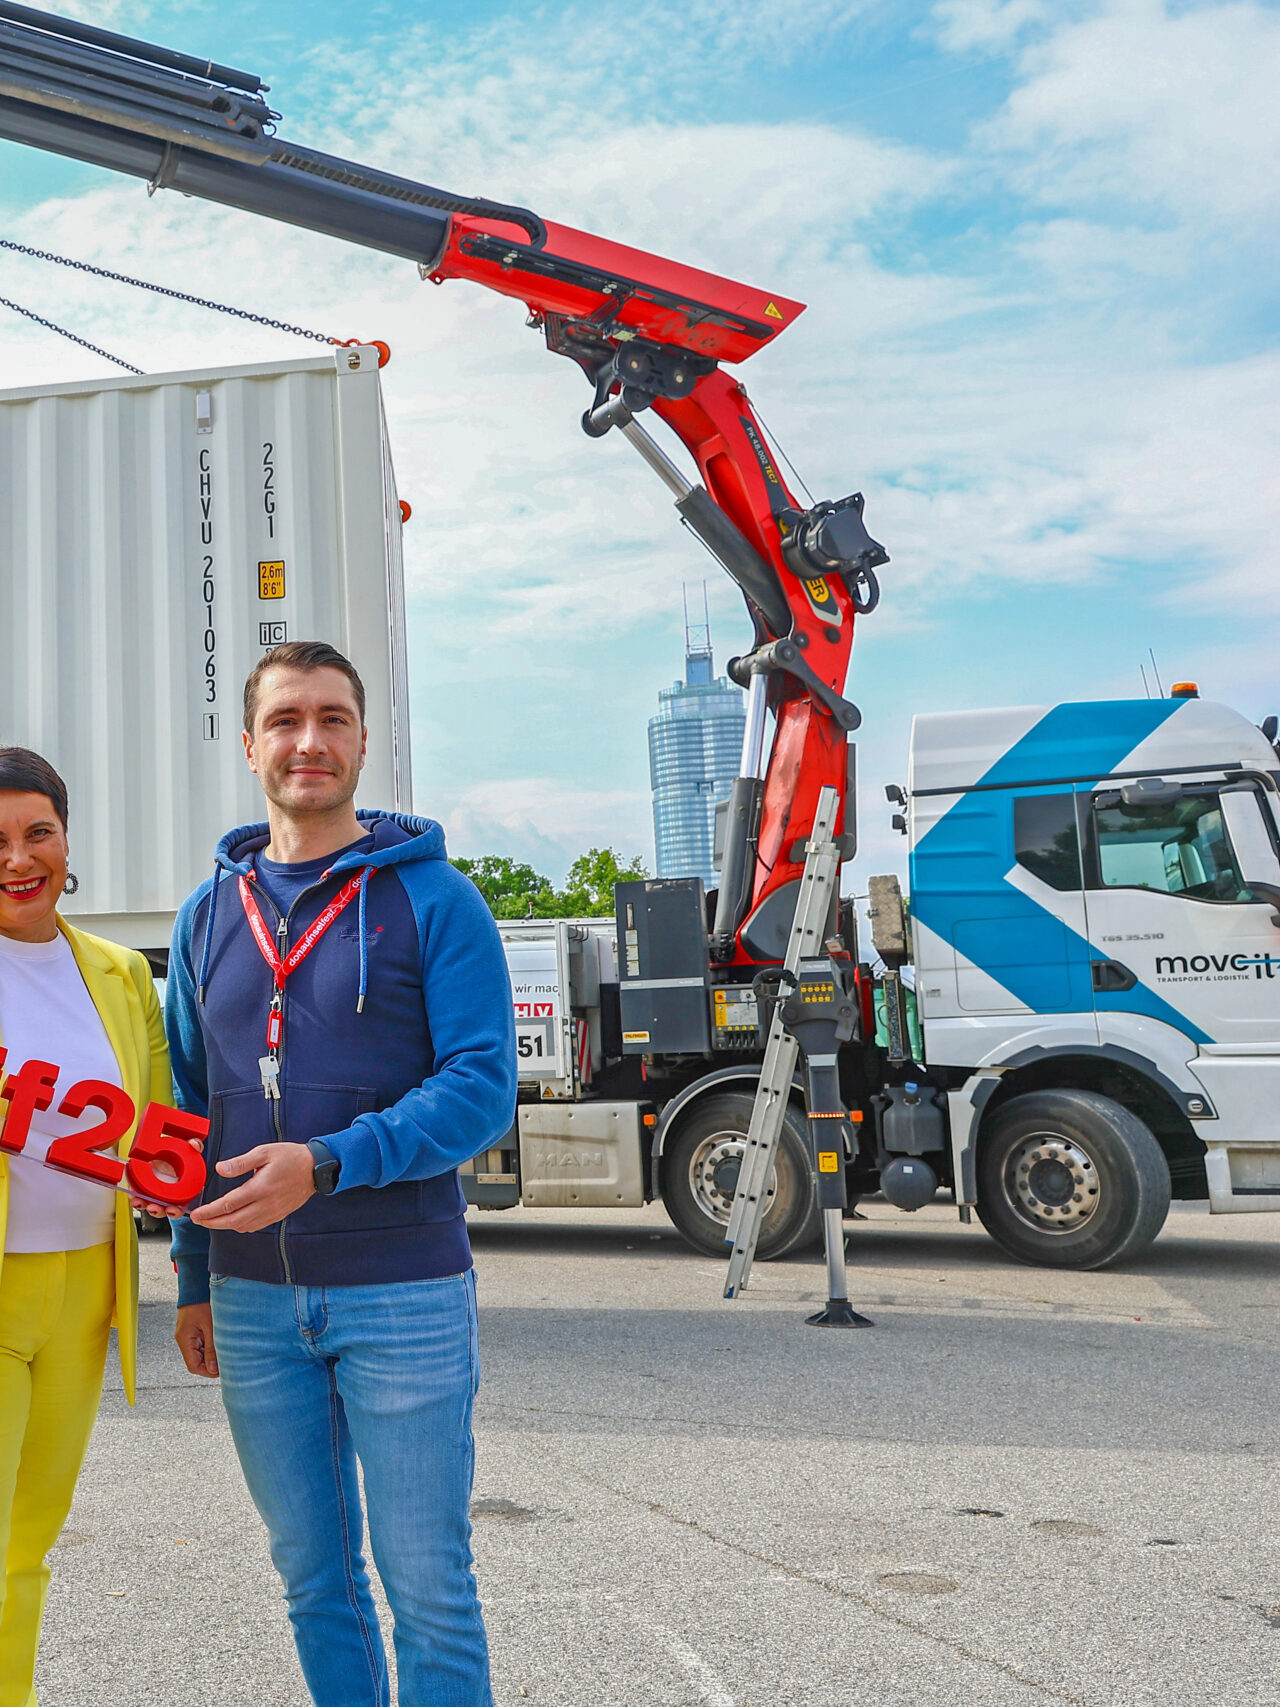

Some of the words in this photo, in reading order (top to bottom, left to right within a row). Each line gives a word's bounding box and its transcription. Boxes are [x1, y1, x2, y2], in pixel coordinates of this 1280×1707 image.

[199, 449, 212, 545] CHVU
[263, 442, 276, 538] 22G1
[203, 555, 216, 702] 201063
[515, 984, 532, 993] wir
[518, 1035, 543, 1058] 51
